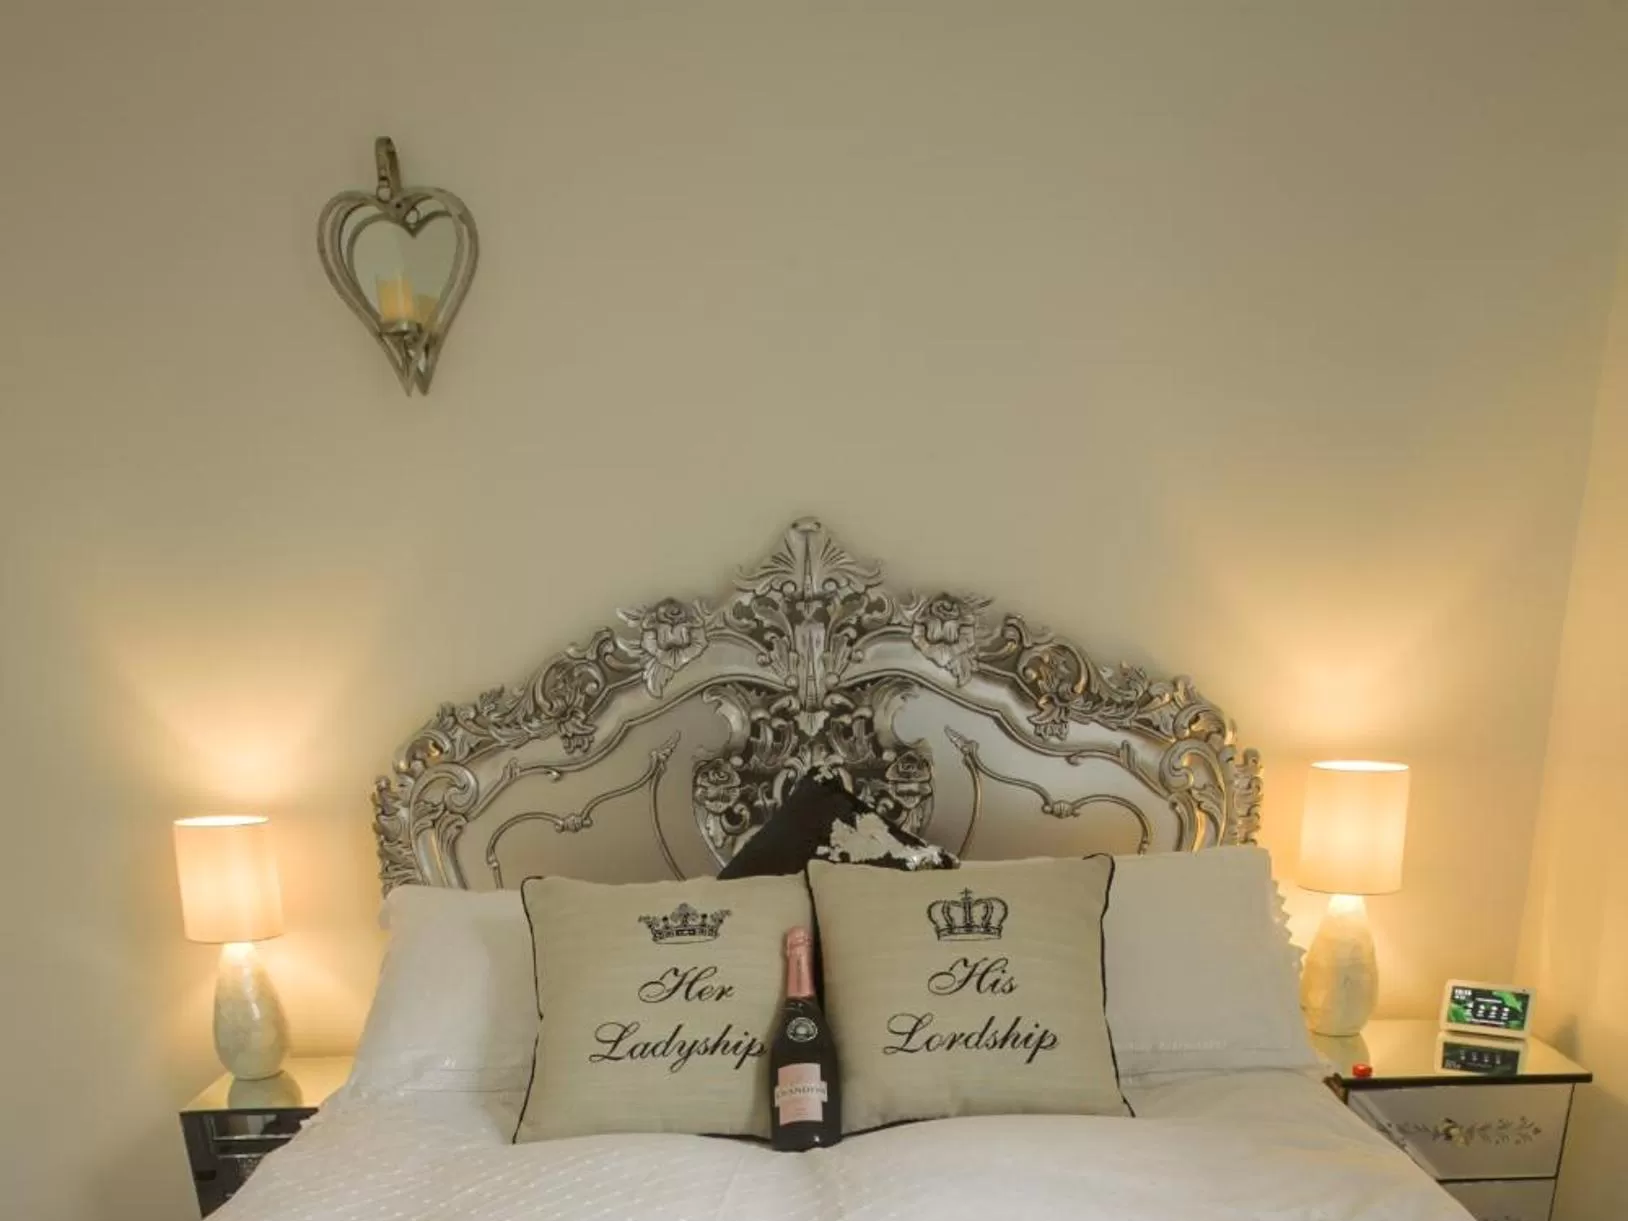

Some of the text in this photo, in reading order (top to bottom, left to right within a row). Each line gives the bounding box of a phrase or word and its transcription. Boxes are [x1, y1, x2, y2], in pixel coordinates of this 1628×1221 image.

[638, 966, 734, 1003] Her
[928, 957, 1018, 996] His
[589, 1022, 768, 1073] Ladyship
[883, 1013, 1058, 1064] Lordship
